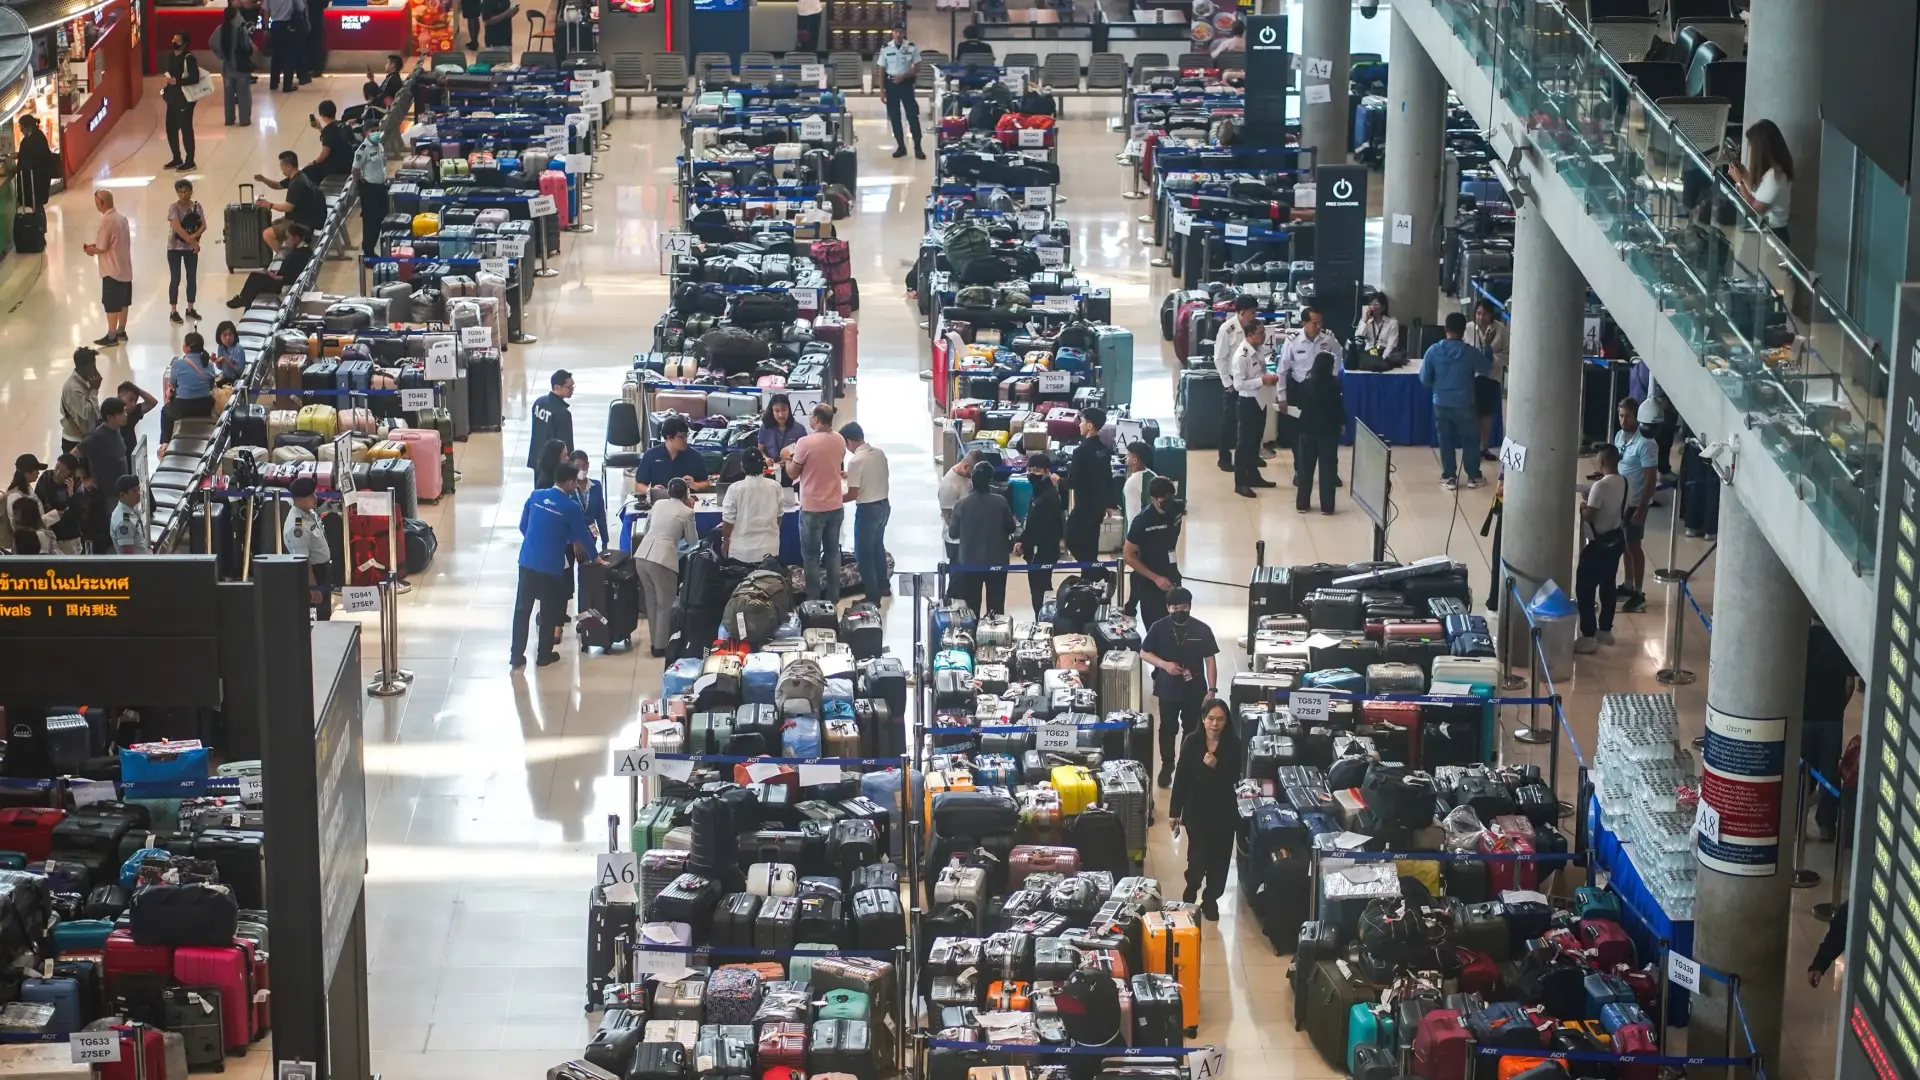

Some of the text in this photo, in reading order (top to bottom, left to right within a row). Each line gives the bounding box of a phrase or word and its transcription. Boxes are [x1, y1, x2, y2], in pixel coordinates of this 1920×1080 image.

[1310, 61, 1328, 76] A4
[1396, 221, 1409, 230] A4
[666, 237, 686, 252] A2
[434, 354, 450, 365] A1
[408, 400, 429, 408] 27SEP
[534, 404, 552, 423] AOT
[1501, 447, 1522, 470] A8
[349, 591, 373, 599] TG941
[351, 600, 374, 609] 27SEP
[66, 604, 118, 617] 国内到达
[1297, 697, 1322, 705] TG575
[1296, 707, 1321, 715] 27SEP
[1045, 729, 1070, 737] TG623
[1725, 723, 1753, 735] ประกาศ
[1043, 740, 1069, 748] 27SEP
[619, 754, 649, 773] A6
[248, 781, 264, 789] TG3
[249, 792, 264, 800] 27S
[1698, 809, 1716, 837] A8
[601, 862, 635, 886] A6
[1674, 958, 1694, 975] TG330
[1673, 971, 1694, 986] 28SEP
[79, 1037, 110, 1046] TG633
[80, 1049, 111, 1059] 27SEP
[1198, 1054, 1222, 1080] A7
